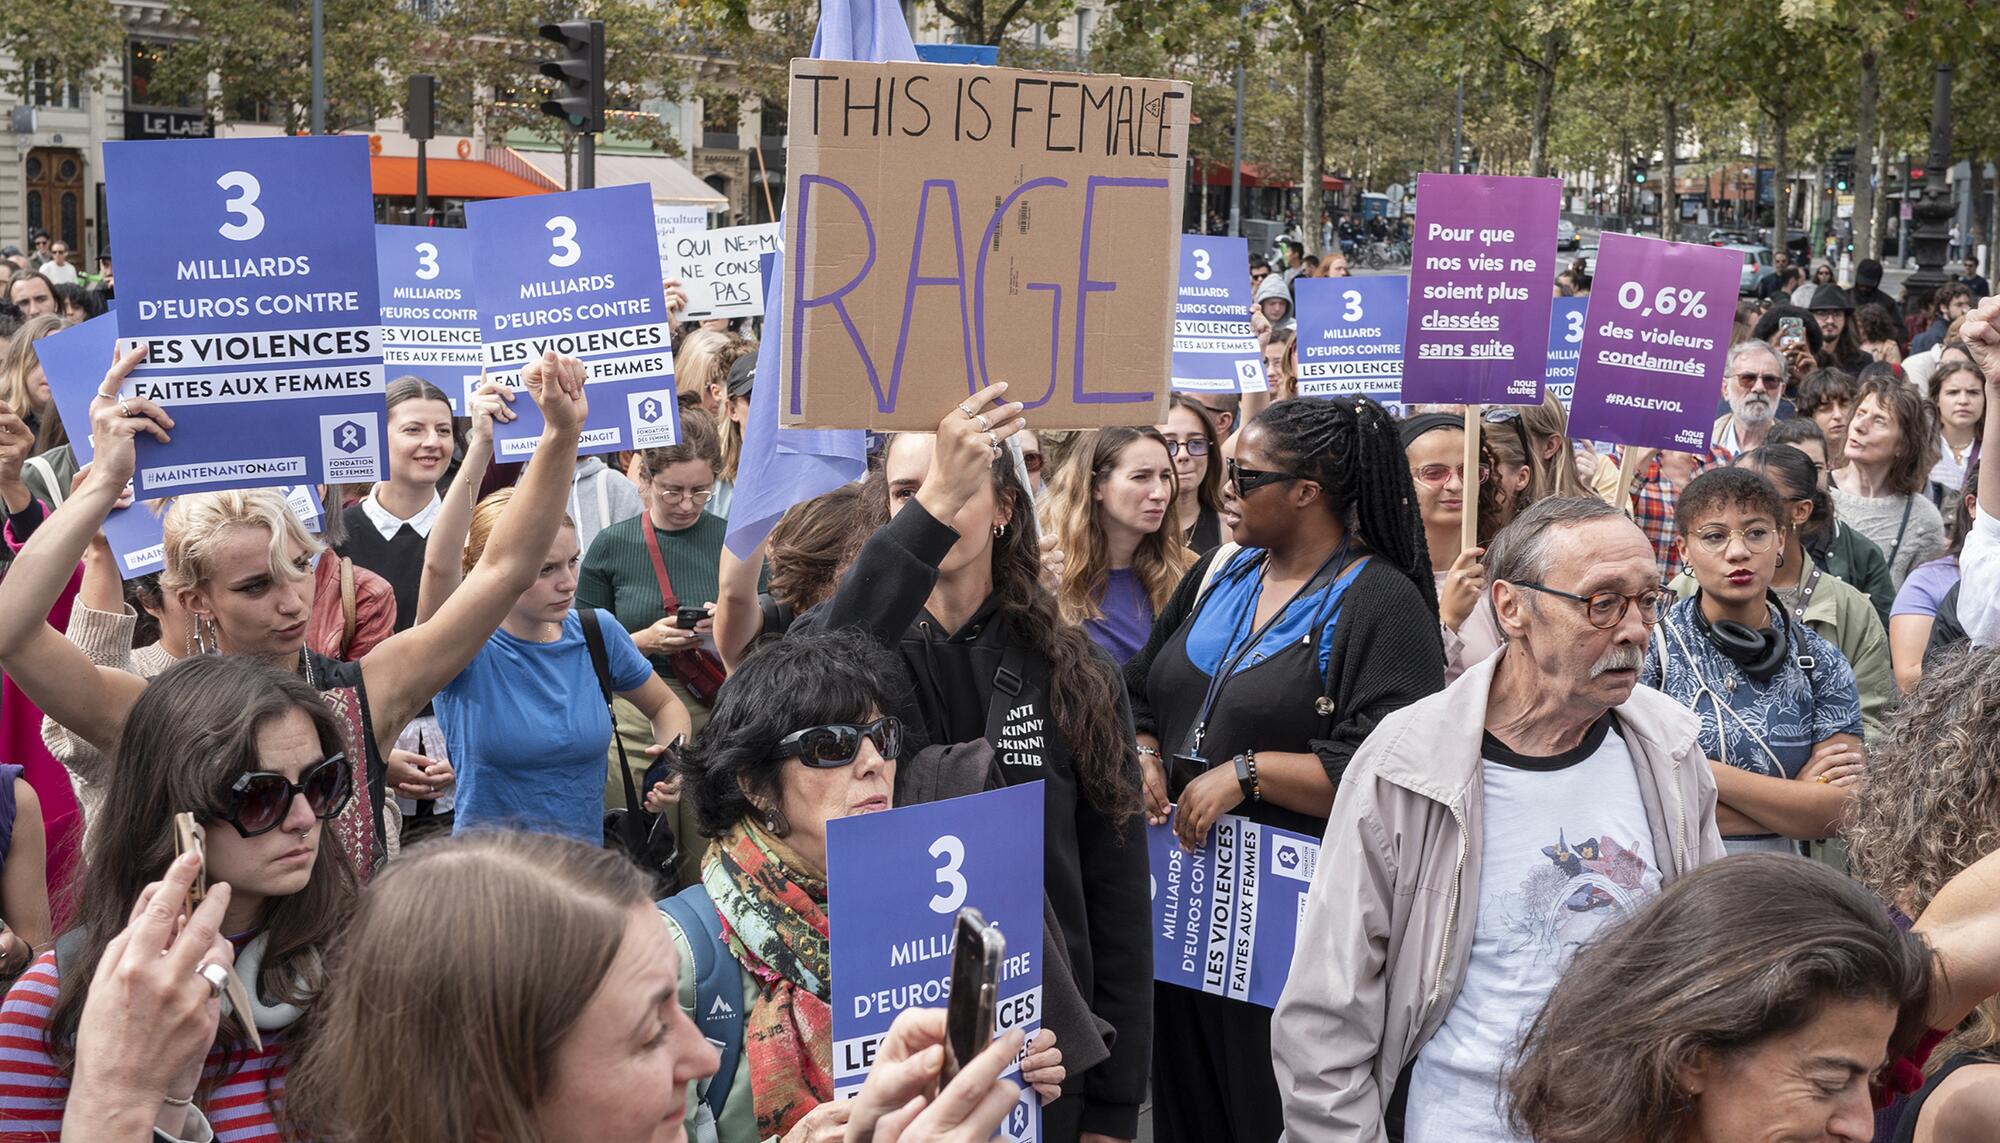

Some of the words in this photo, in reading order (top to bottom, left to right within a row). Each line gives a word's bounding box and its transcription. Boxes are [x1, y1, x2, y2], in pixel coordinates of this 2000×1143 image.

[795, 74, 931, 136] THIS
[955, 76, 992, 141] IS
[1011, 78, 1185, 158] FEMALE
[216, 170, 265, 241] 3
[545, 215, 582, 268] 3
[677, 238, 711, 258] QUI
[724, 236, 748, 253] NE
[760, 234, 778, 250] M
[1428, 223, 1474, 243] Pour
[1479, 228, 1515, 246] que
[177, 255, 310, 280] MILLIARDS
[415, 242, 440, 280] 3
[681, 264, 704, 278] NE
[1192, 248, 1212, 280] 3
[1426, 257, 1461, 271] nos
[1468, 253, 1504, 272] vies
[1510, 259, 1536, 272] ne
[393, 287, 462, 300] MILLIARDS
[520, 274, 615, 300] MILLIARDS
[710, 282, 751, 301] PAS
[790, 174, 1170, 414] RAGE
[1179, 286, 1229, 298] MILLIARDS
[1423, 282, 1483, 300] soient
[1487, 282, 1529, 304] plus
[255, 291, 359, 315] CONTRE
[1176, 303, 1207, 314] EUROS
[1208, 305, 1248, 315] CONTRE
[1341, 290, 1364, 322] 3
[1618, 281, 1708, 319] 0,6%
[433, 308, 477, 320] CONTR
[494, 307, 572, 330] D'EUROS
[577, 298, 651, 320] CONTRE
[1421, 310, 1500, 329] classées
[400, 329, 481, 342] VIOLENCE
[1184, 322, 1251, 335] VIOLENCES
[1323, 328, 1381, 339] MILLIARDS
[1564, 310, 1584, 343] 3
[1599, 322, 1634, 341] des
[1641, 327, 1714, 350] violeurs
[191, 331, 371, 362] VIOLENCES
[490, 342, 527, 362] LES
[533, 327, 661, 357] VIOLENCES
[1173, 341, 1193, 349] ITES
[1196, 341, 1214, 349] AUX
[1216, 341, 1254, 350] FEMMES
[1356, 344, 1401, 354] CONTRE
[1419, 343, 1464, 358] sans
[1470, 339, 1515, 358] suite
[383, 351, 409, 361] ITES
[413, 352, 437, 361] AUX
[441, 352, 483, 362] FEMME
[594, 358, 663, 378] FEMMES
[1598, 348, 1706, 374] condamnés
[1303, 365, 1326, 376] LES
[1329, 362, 1404, 374] VIOLENCES
[135, 381, 213, 400] FAITES
[219, 378, 269, 396] AUX
[275, 371, 372, 392] FEMMES
[1304, 383, 1337, 393] FAITES
[1340, 382, 1361, 390] AUX
[1507, 386, 1536, 394] toutes
[1605, 393, 1683, 413] #RASLEVIOL
[1675, 434, 1703, 445] toutes
[1682, 429, 1704, 438] nous
[148, 461, 298, 483] #MAINTENANTONAGIT
[329, 459, 374, 467] FONDATION
[1002, 719, 1044, 736] KINNY
[1003, 752, 1043, 767] CLUB
[928, 834, 968, 914] 3
[1242, 831, 1256, 897] FEMMES
[1162, 849, 1182, 940] MILLIARDS
[1211, 824, 1234, 945] VIOLENCES
[1239, 901, 1254, 936] AUX
[998, 951, 1031, 983] TRE
[1206, 950, 1224, 987] LES
[1233, 939, 1250, 991] FAITES
